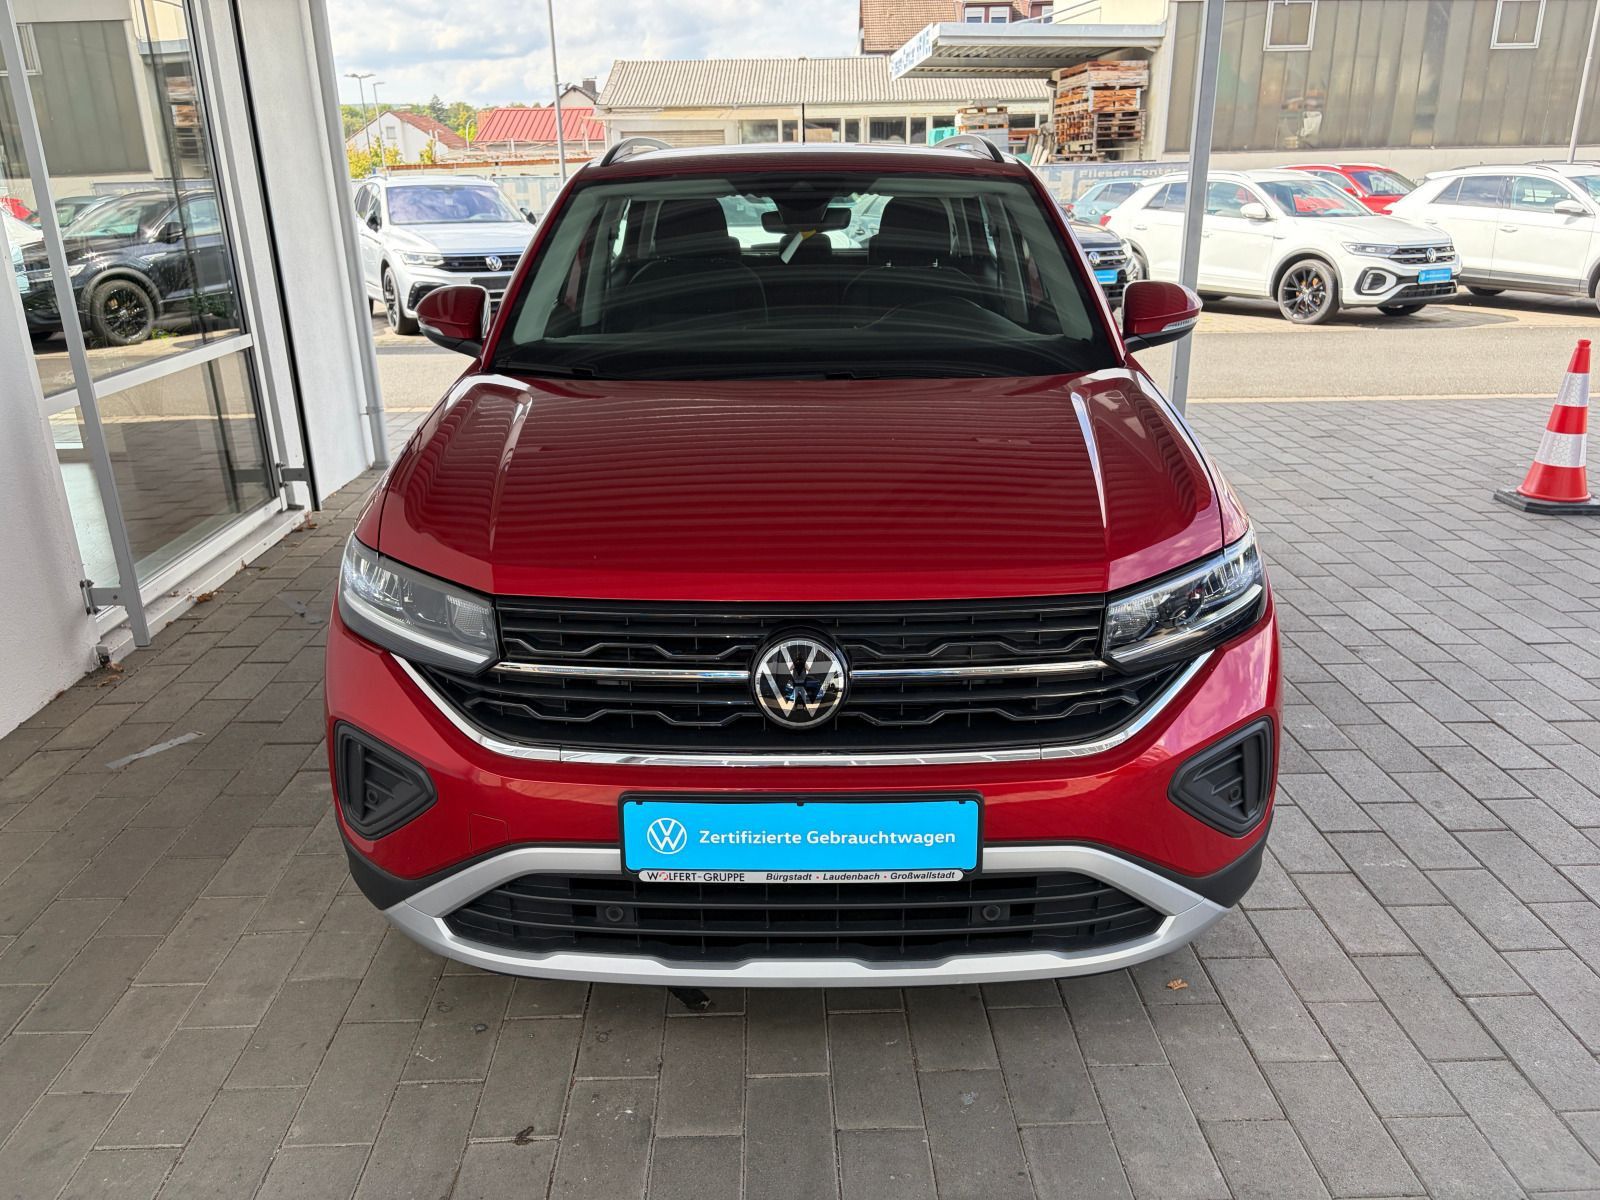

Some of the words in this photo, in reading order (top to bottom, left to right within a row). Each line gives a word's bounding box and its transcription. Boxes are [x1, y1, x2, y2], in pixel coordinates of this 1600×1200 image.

[699, 830, 802, 845] Zertifizierte
[806, 830, 956, 847] Gebrauchtwagen
[766, 872, 812, 882] Bürgstadt
[823, 872, 880, 882] Laudenbach
[890, 871, 956, 881] Großwallstadt
